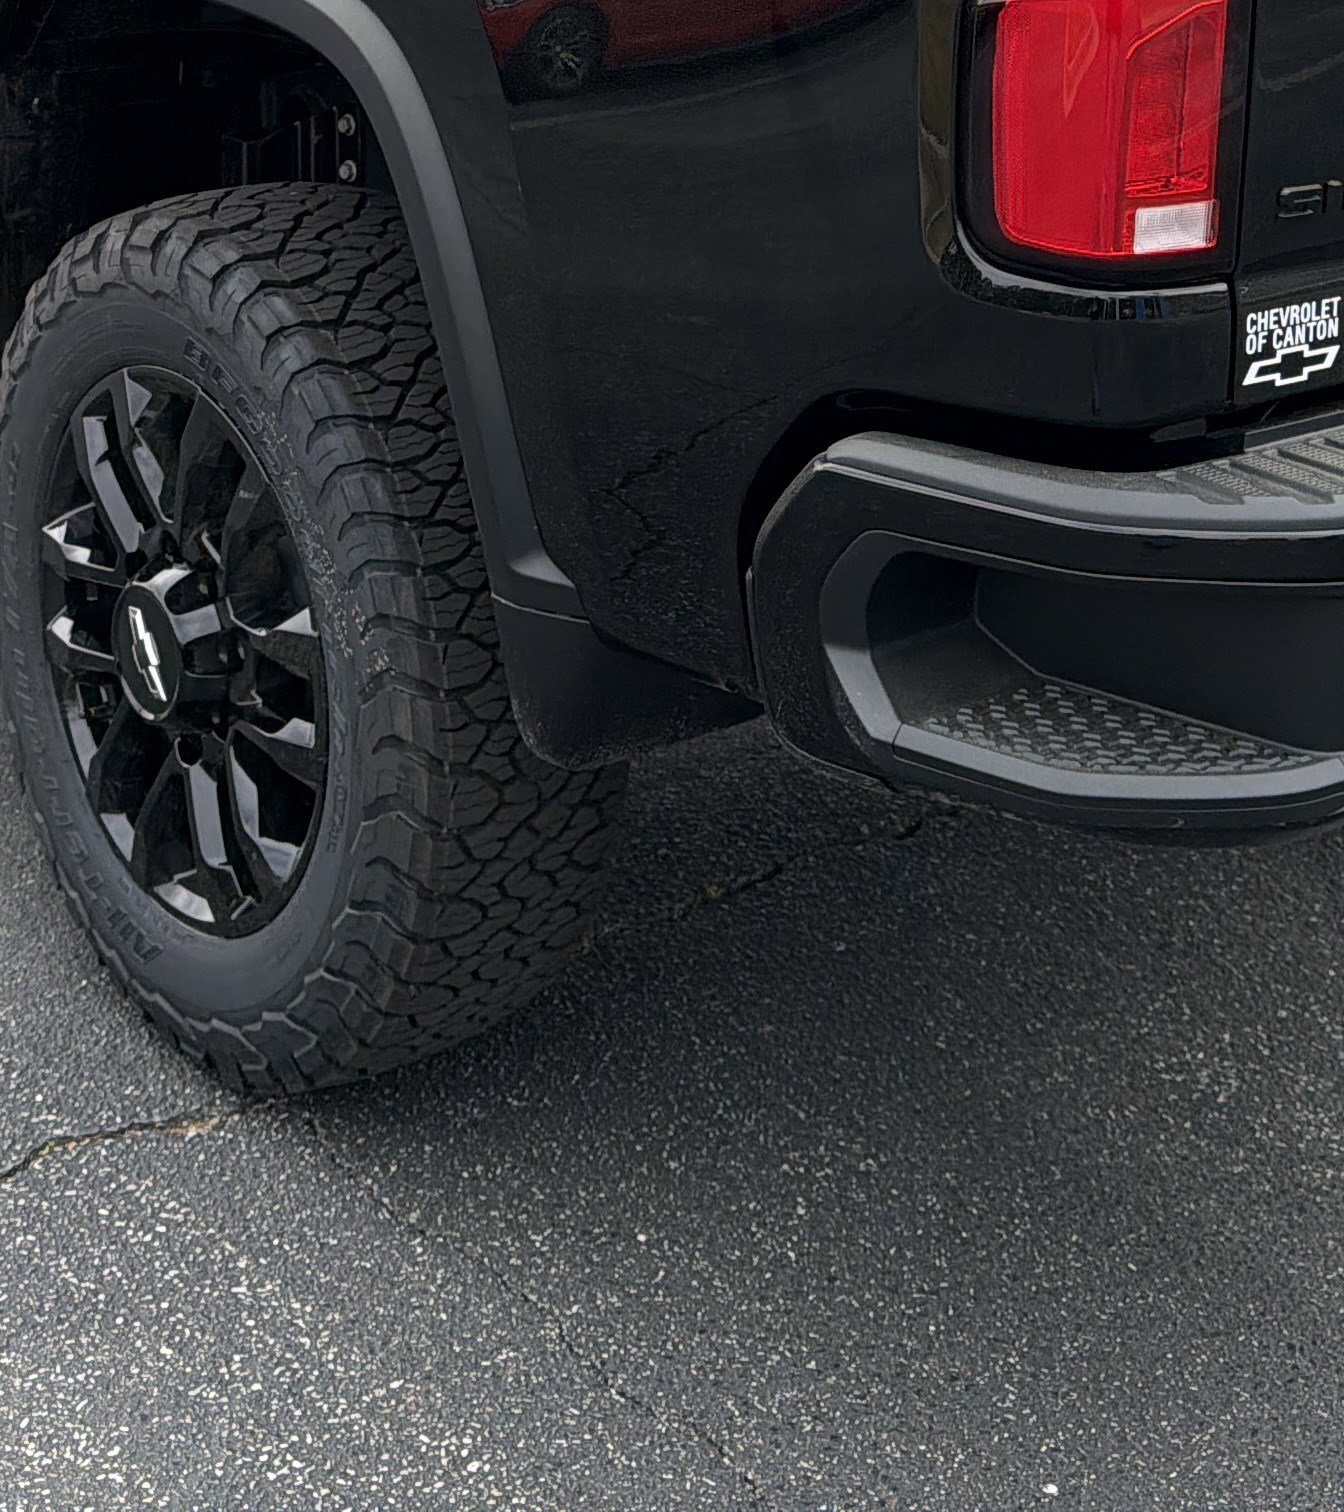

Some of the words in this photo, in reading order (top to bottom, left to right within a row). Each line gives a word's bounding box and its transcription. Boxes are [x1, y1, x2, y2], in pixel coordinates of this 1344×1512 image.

[1246, 295, 1342, 334] CHEVROLET
[1245, 330, 1269, 355] OF
[1272, 317, 1339, 349] CANTON
